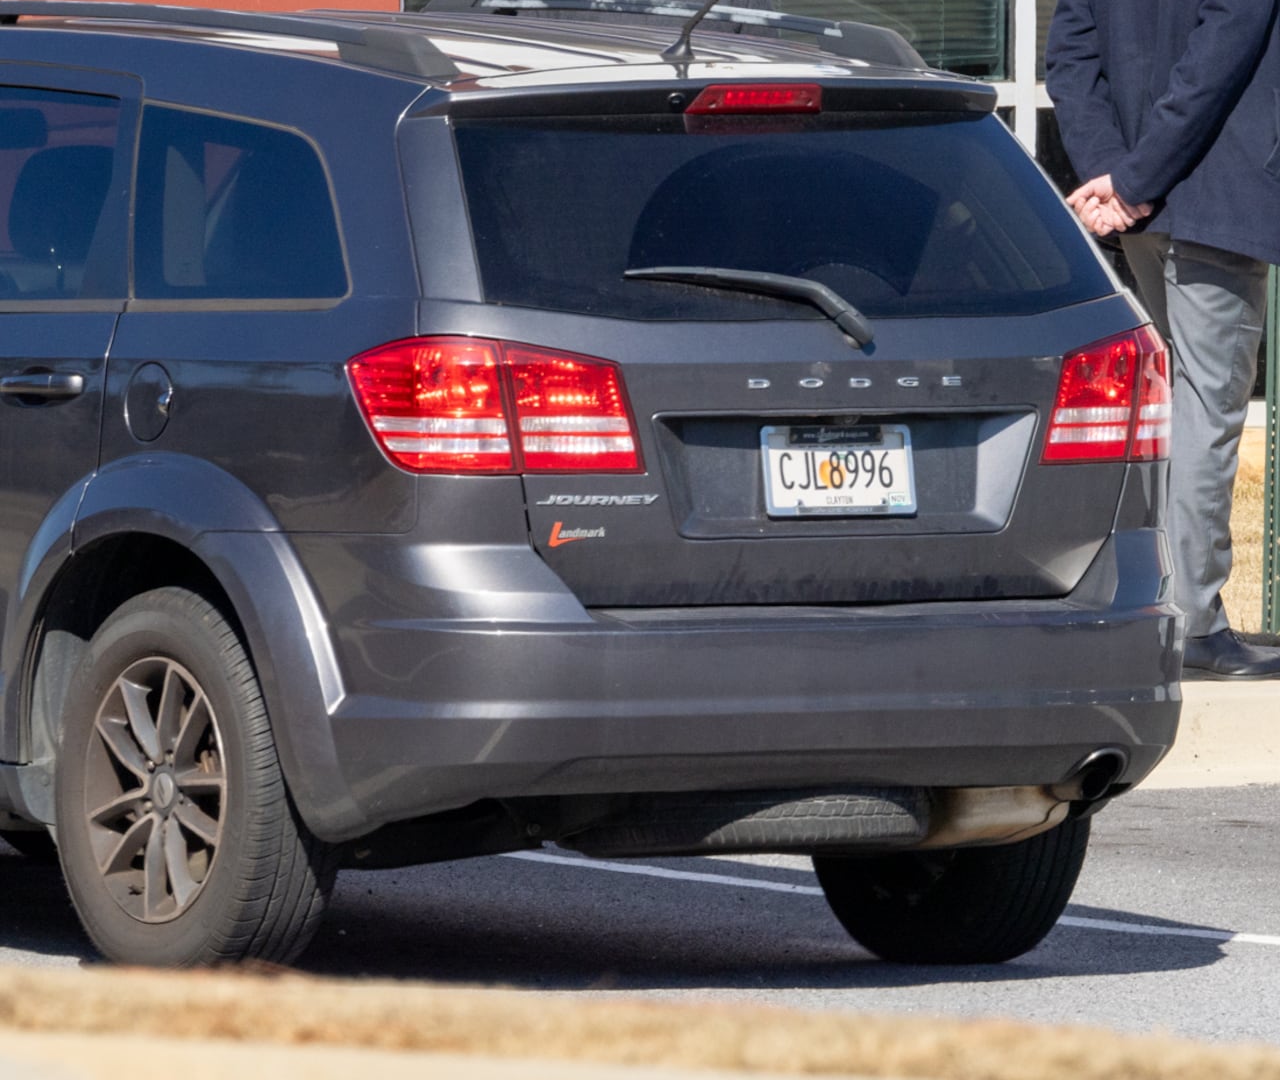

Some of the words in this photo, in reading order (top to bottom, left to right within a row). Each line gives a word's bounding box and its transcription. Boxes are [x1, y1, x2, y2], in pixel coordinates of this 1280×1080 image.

[748, 376, 963, 389] DODGE
[780, 451, 894, 490] CJL8996
[536, 493, 660, 506] JOURNEY
[891, 495, 906, 503] NOV
[547, 520, 606, 548] Landmark
